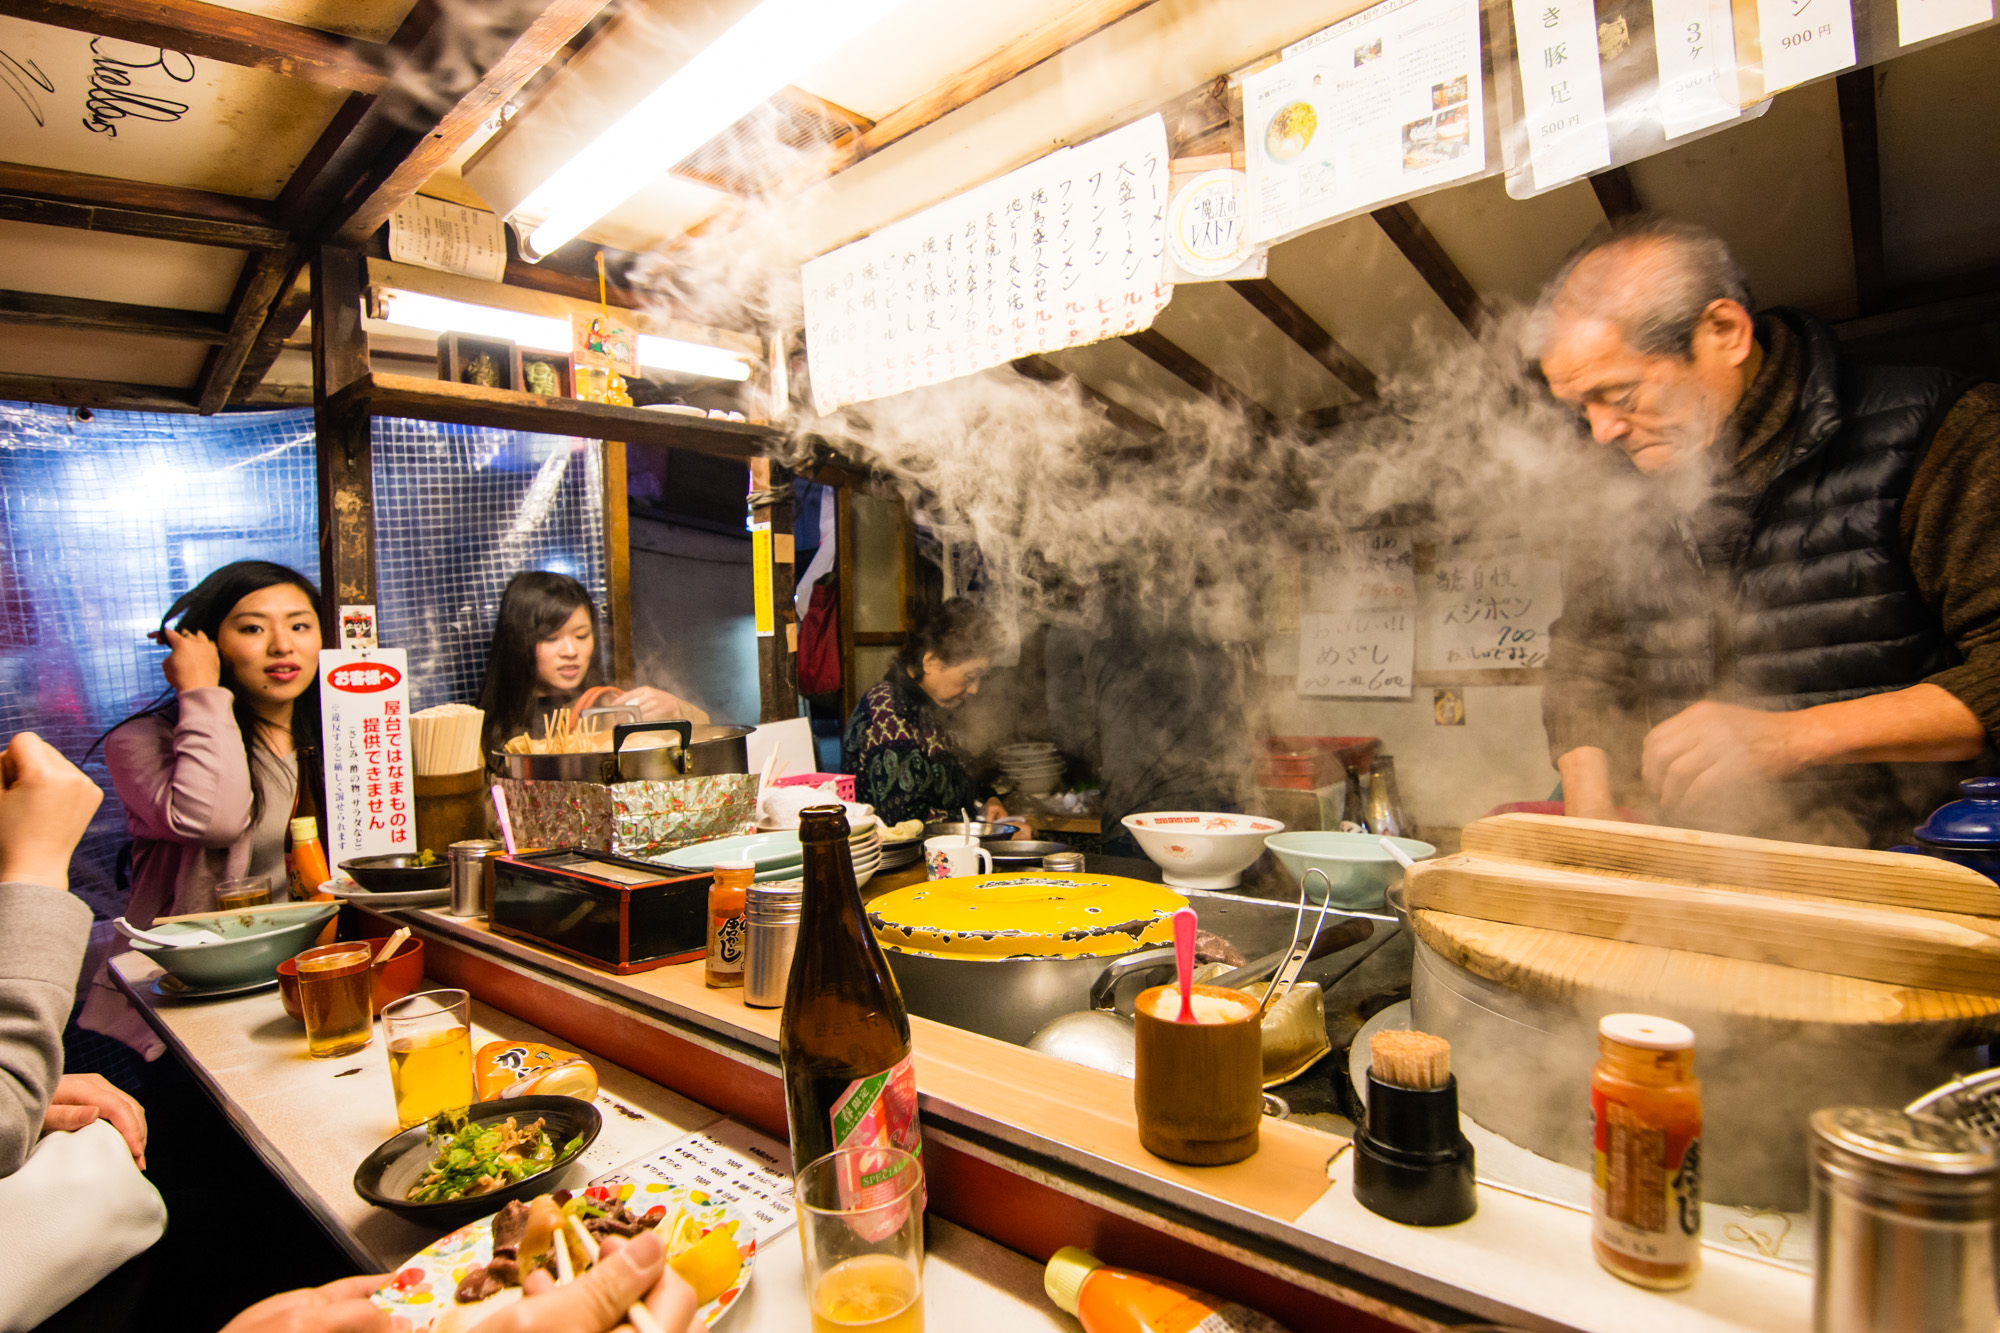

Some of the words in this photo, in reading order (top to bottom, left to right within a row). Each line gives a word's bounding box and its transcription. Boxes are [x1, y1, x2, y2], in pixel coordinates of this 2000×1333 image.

[1056, 180, 1081, 291] ワンタンメン
[1087, 172, 1109, 266] ワンタン
[1115, 161, 1143, 280] 大盛ラーメン
[1143, 151, 1165, 259] ラーメン
[334, 669, 395, 688] お客様へ
[362, 718, 385, 831] 提供できません
[384, 700, 407, 844] 屋台ではなまものは
